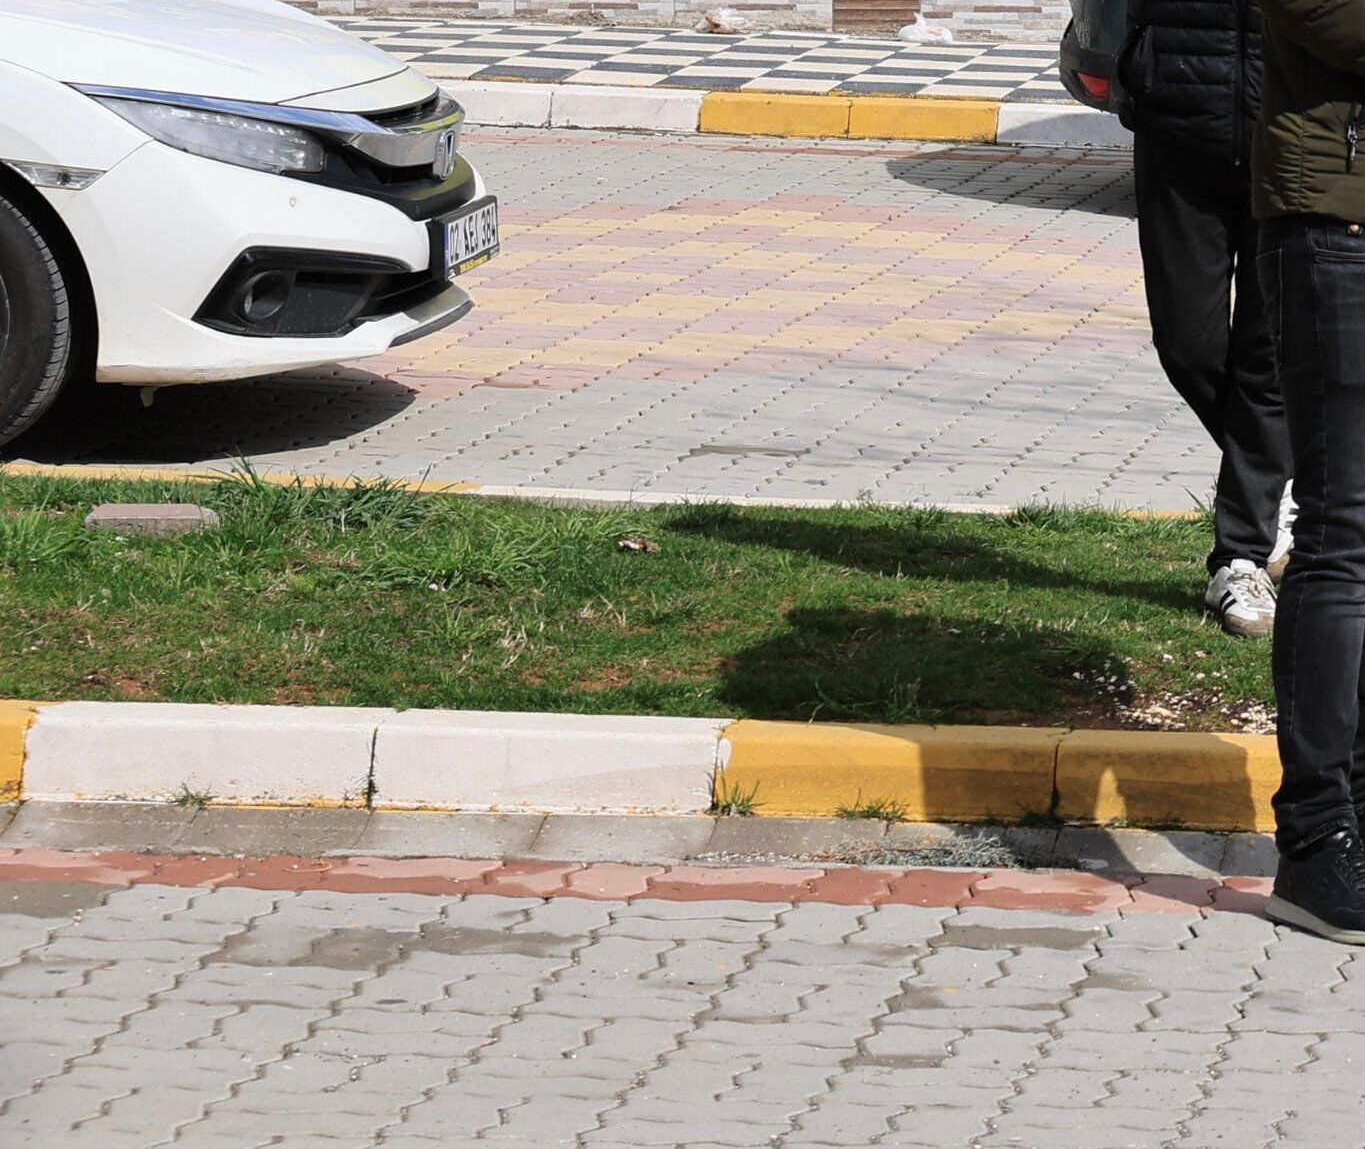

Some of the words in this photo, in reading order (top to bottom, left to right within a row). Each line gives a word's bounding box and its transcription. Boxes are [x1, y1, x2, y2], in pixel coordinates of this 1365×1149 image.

[449, 222, 460, 263] 02
[463, 213, 479, 256] AEJ
[481, 204, 496, 248] 384
